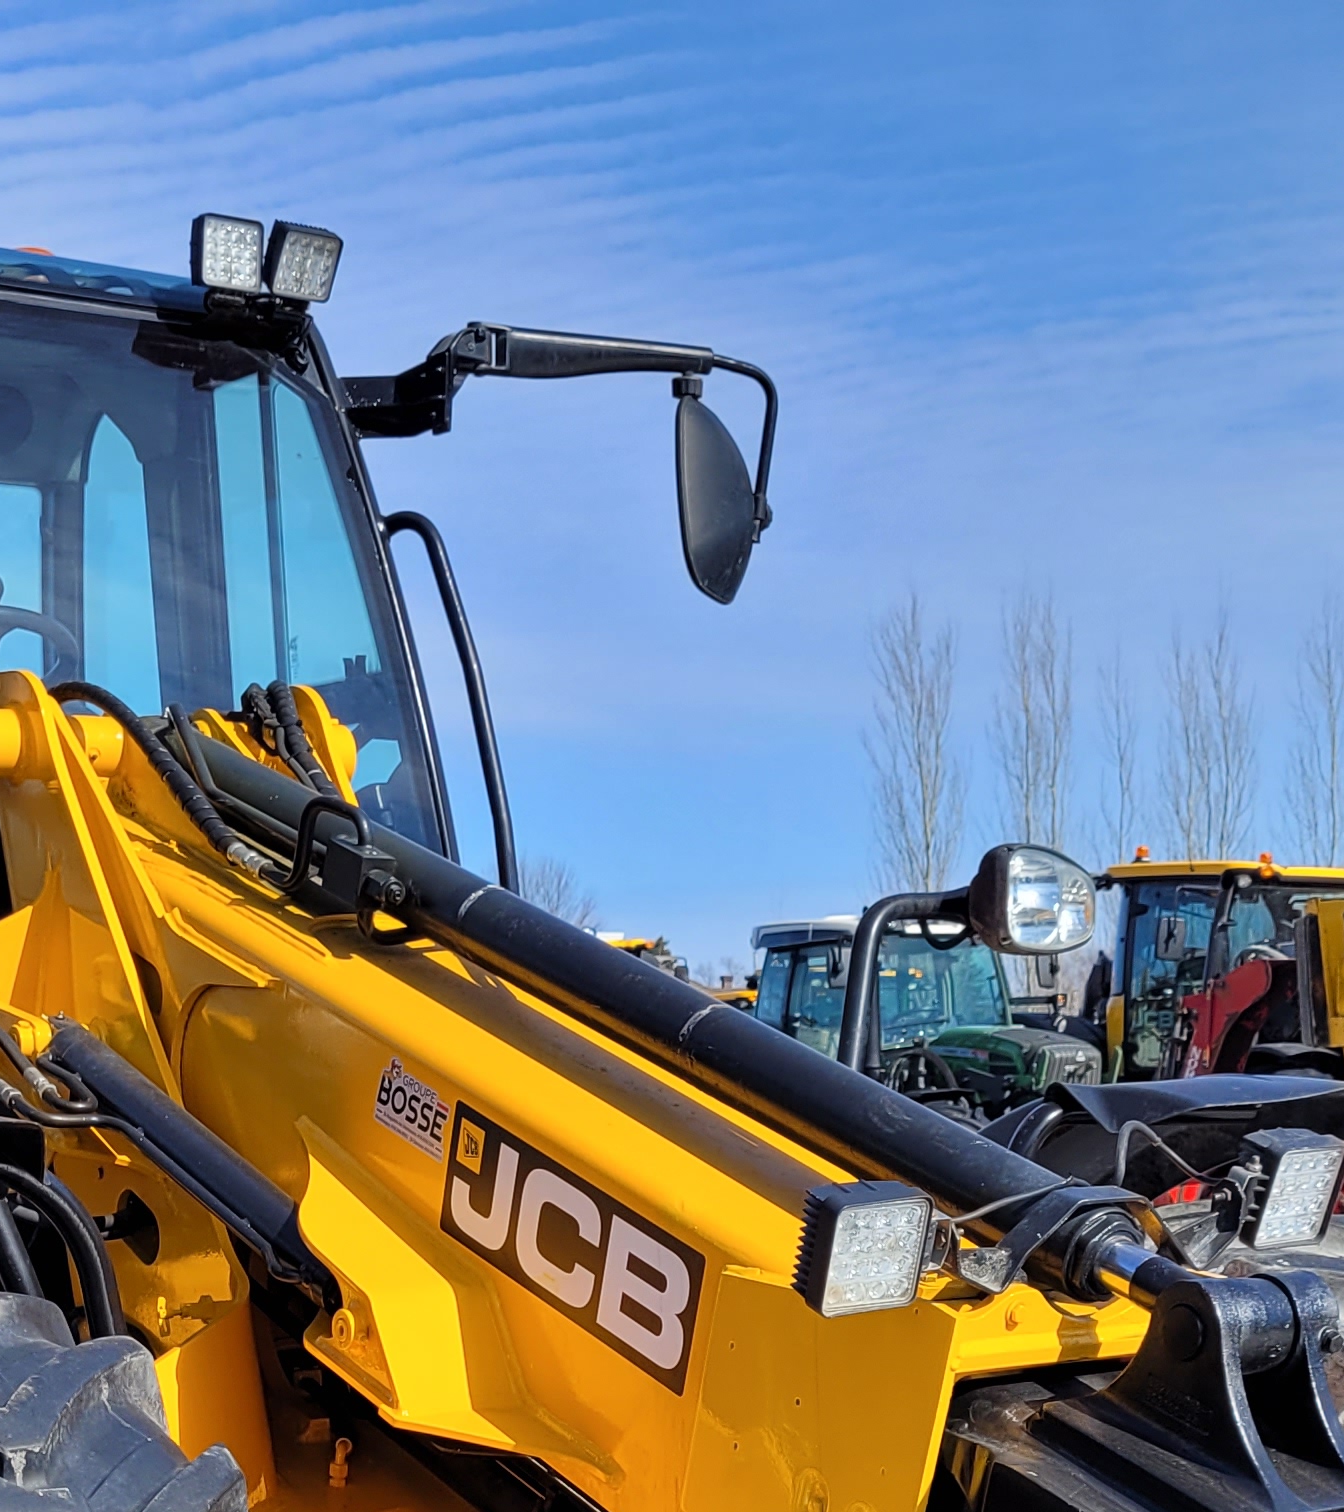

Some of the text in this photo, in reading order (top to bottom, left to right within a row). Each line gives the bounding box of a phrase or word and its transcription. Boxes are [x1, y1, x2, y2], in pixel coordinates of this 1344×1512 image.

[376, 1073, 448, 1144] BOSSE
[402, 1074, 437, 1104] GROUPE
[451, 1142, 690, 1370] JCB
